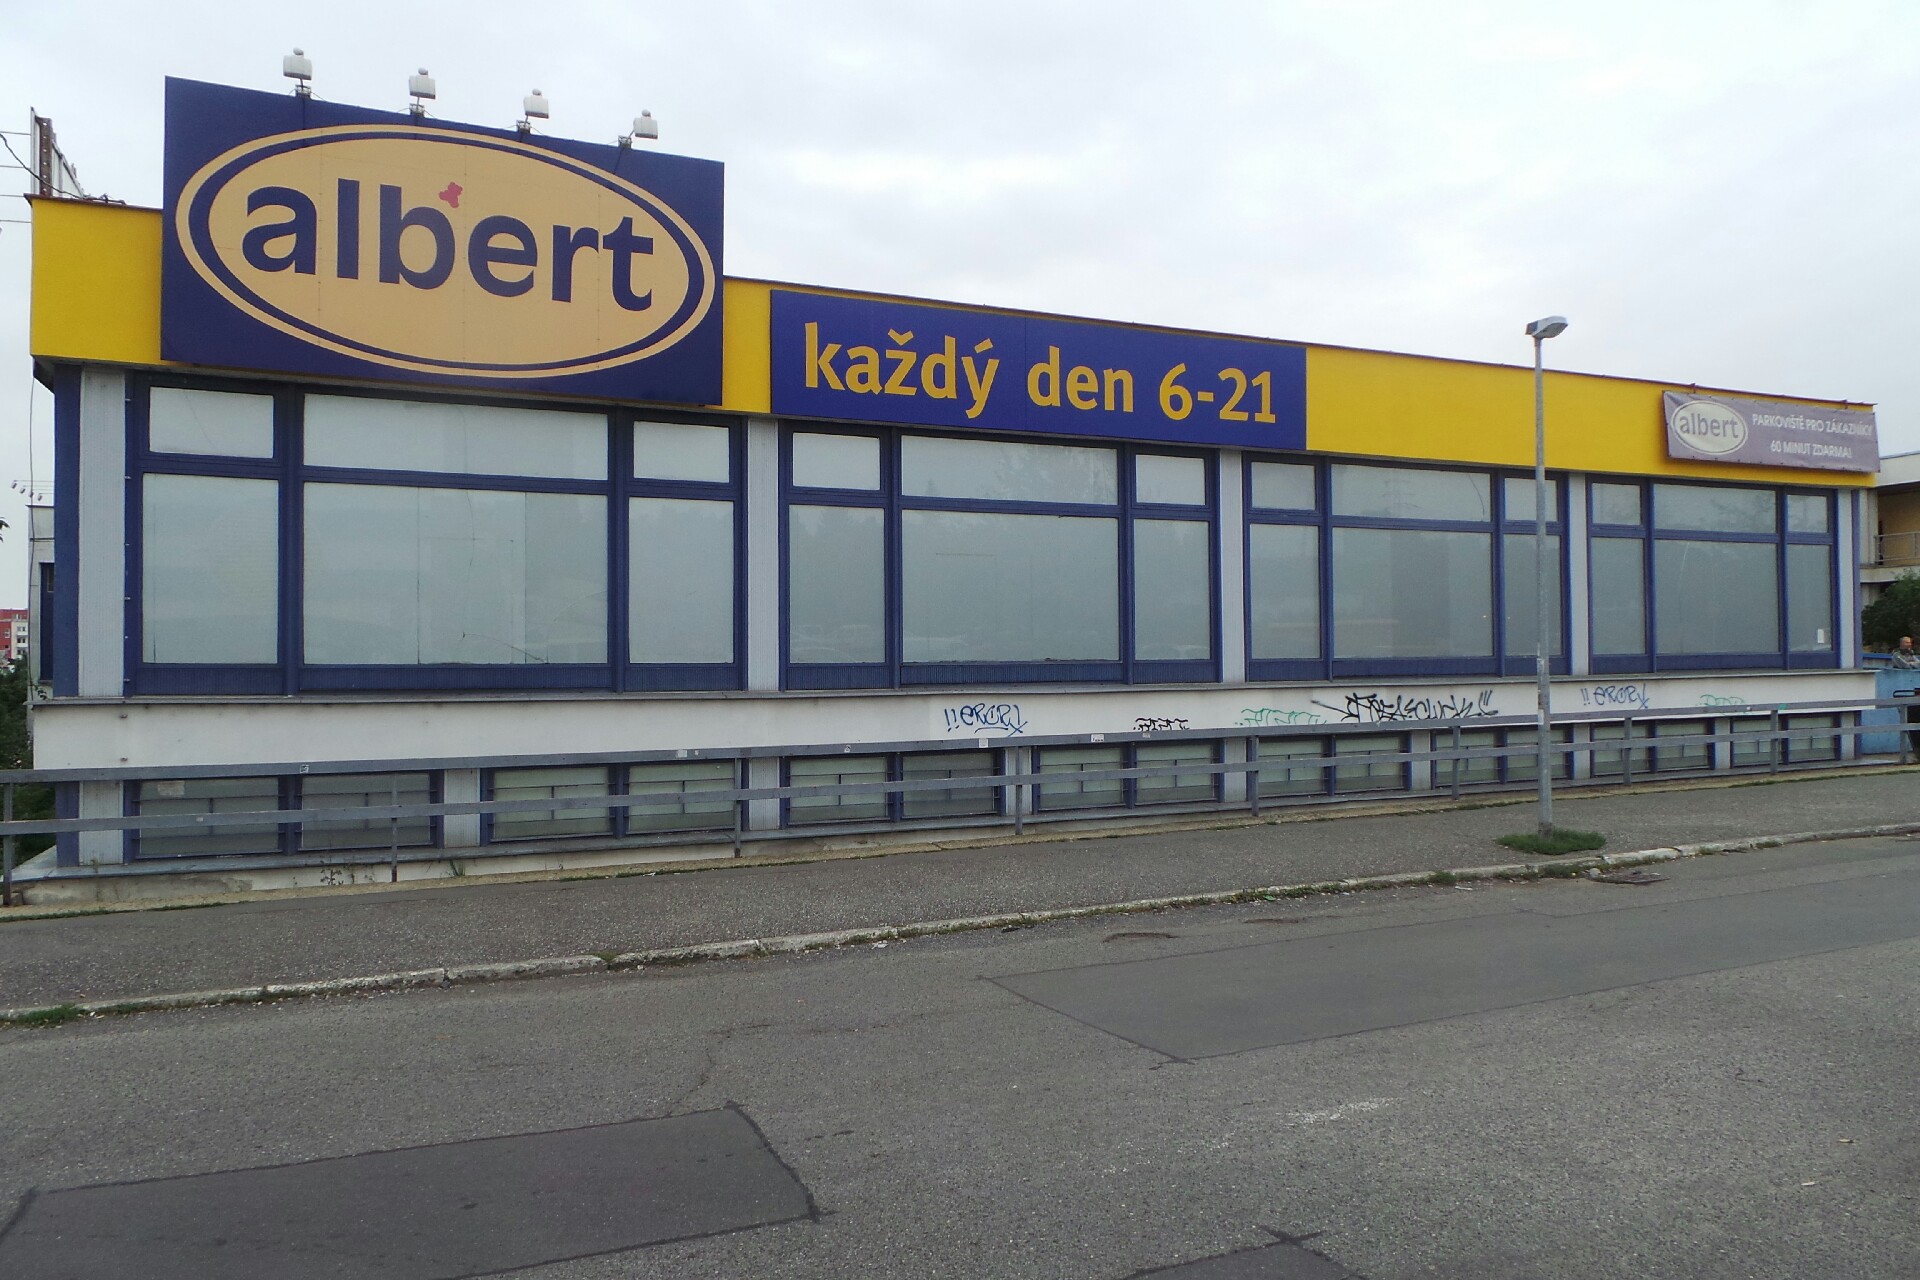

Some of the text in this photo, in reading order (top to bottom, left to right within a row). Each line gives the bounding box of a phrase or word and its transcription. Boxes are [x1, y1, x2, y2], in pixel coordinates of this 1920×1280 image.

[241, 178, 654, 311] albert
[804, 321, 1276, 424] každý den 6-21
[1678, 412, 1739, 439] albert
[1752, 414, 1805, 430] PARKOVIŠTĚ
[1806, 418, 1825, 432] PRO
[1770, 440, 1782, 453] 60
[1783, 441, 1811, 455] MINUT
